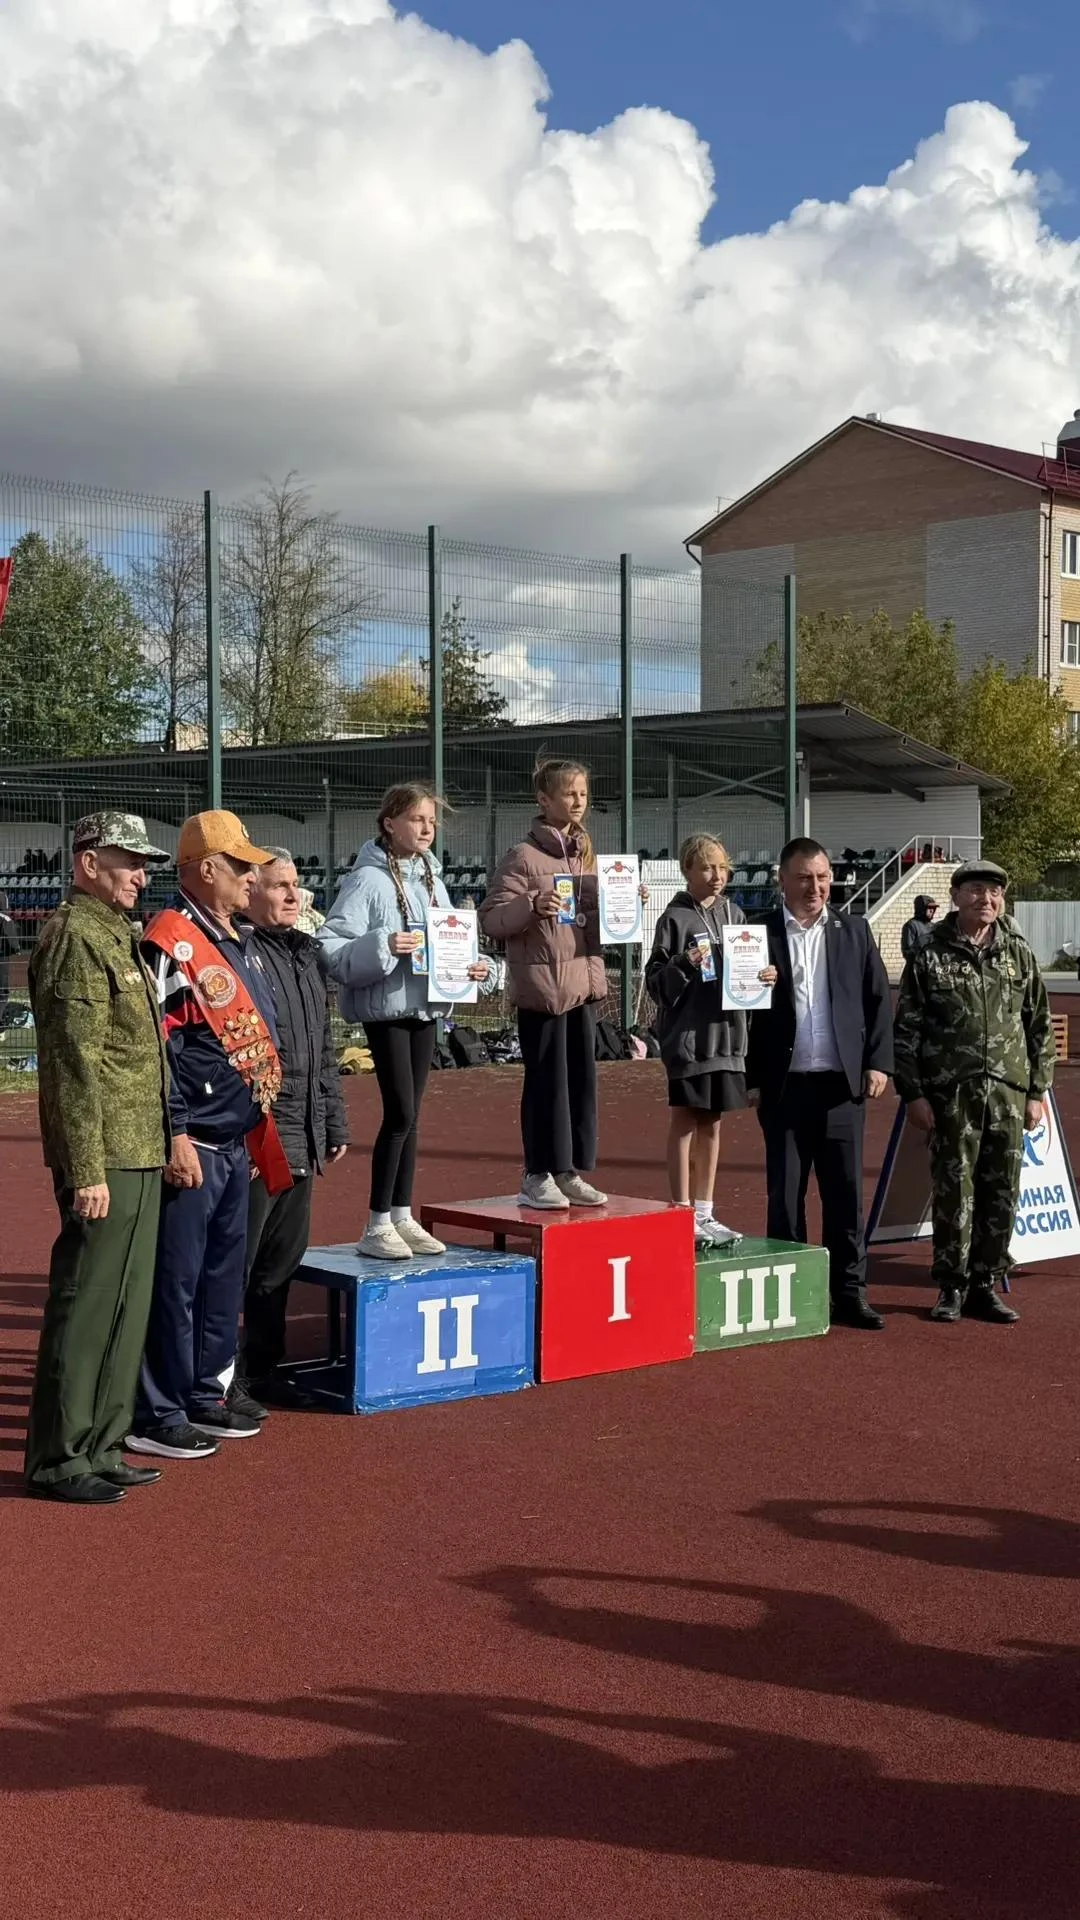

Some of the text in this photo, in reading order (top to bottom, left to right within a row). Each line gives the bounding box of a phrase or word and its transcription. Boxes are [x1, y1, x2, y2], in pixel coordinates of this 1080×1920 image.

[1014, 1210, 1072, 1236] ОССИЯ
[1017, 1185, 1066, 1211] ИНАЯ
[607, 1255, 632, 1323] I
[720, 1263, 797, 1338] III
[417, 1294, 479, 1374] II
